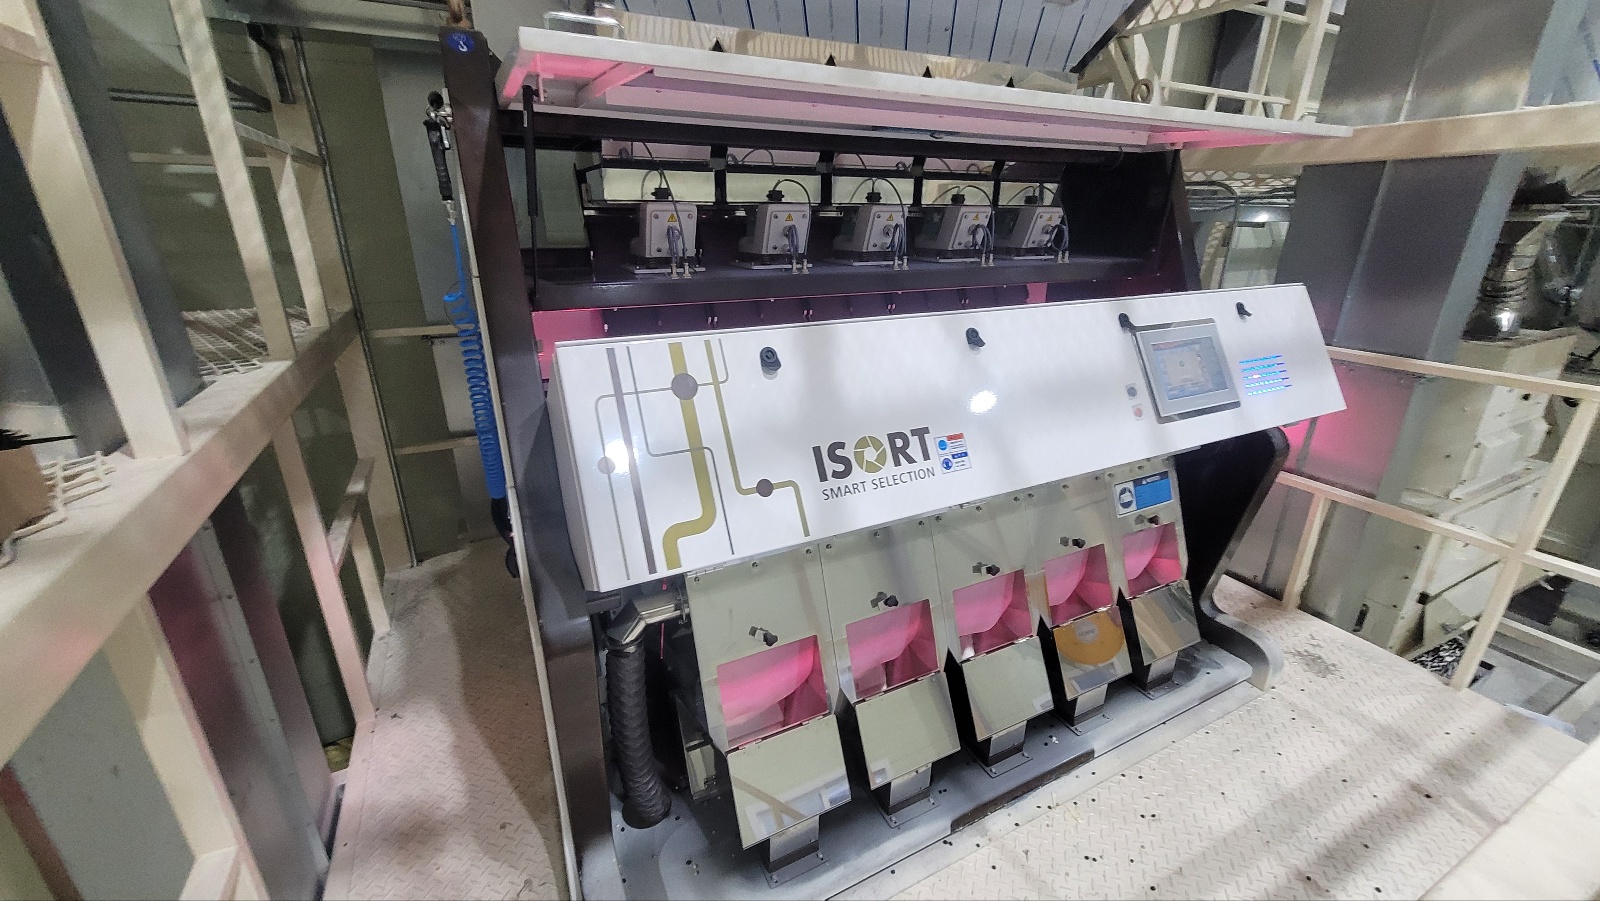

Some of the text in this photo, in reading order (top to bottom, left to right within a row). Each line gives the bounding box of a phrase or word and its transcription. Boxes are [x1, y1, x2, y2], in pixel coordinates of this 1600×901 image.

[812, 426, 931, 482] ISORT
[822, 467, 936, 500] SMART SELECTION
